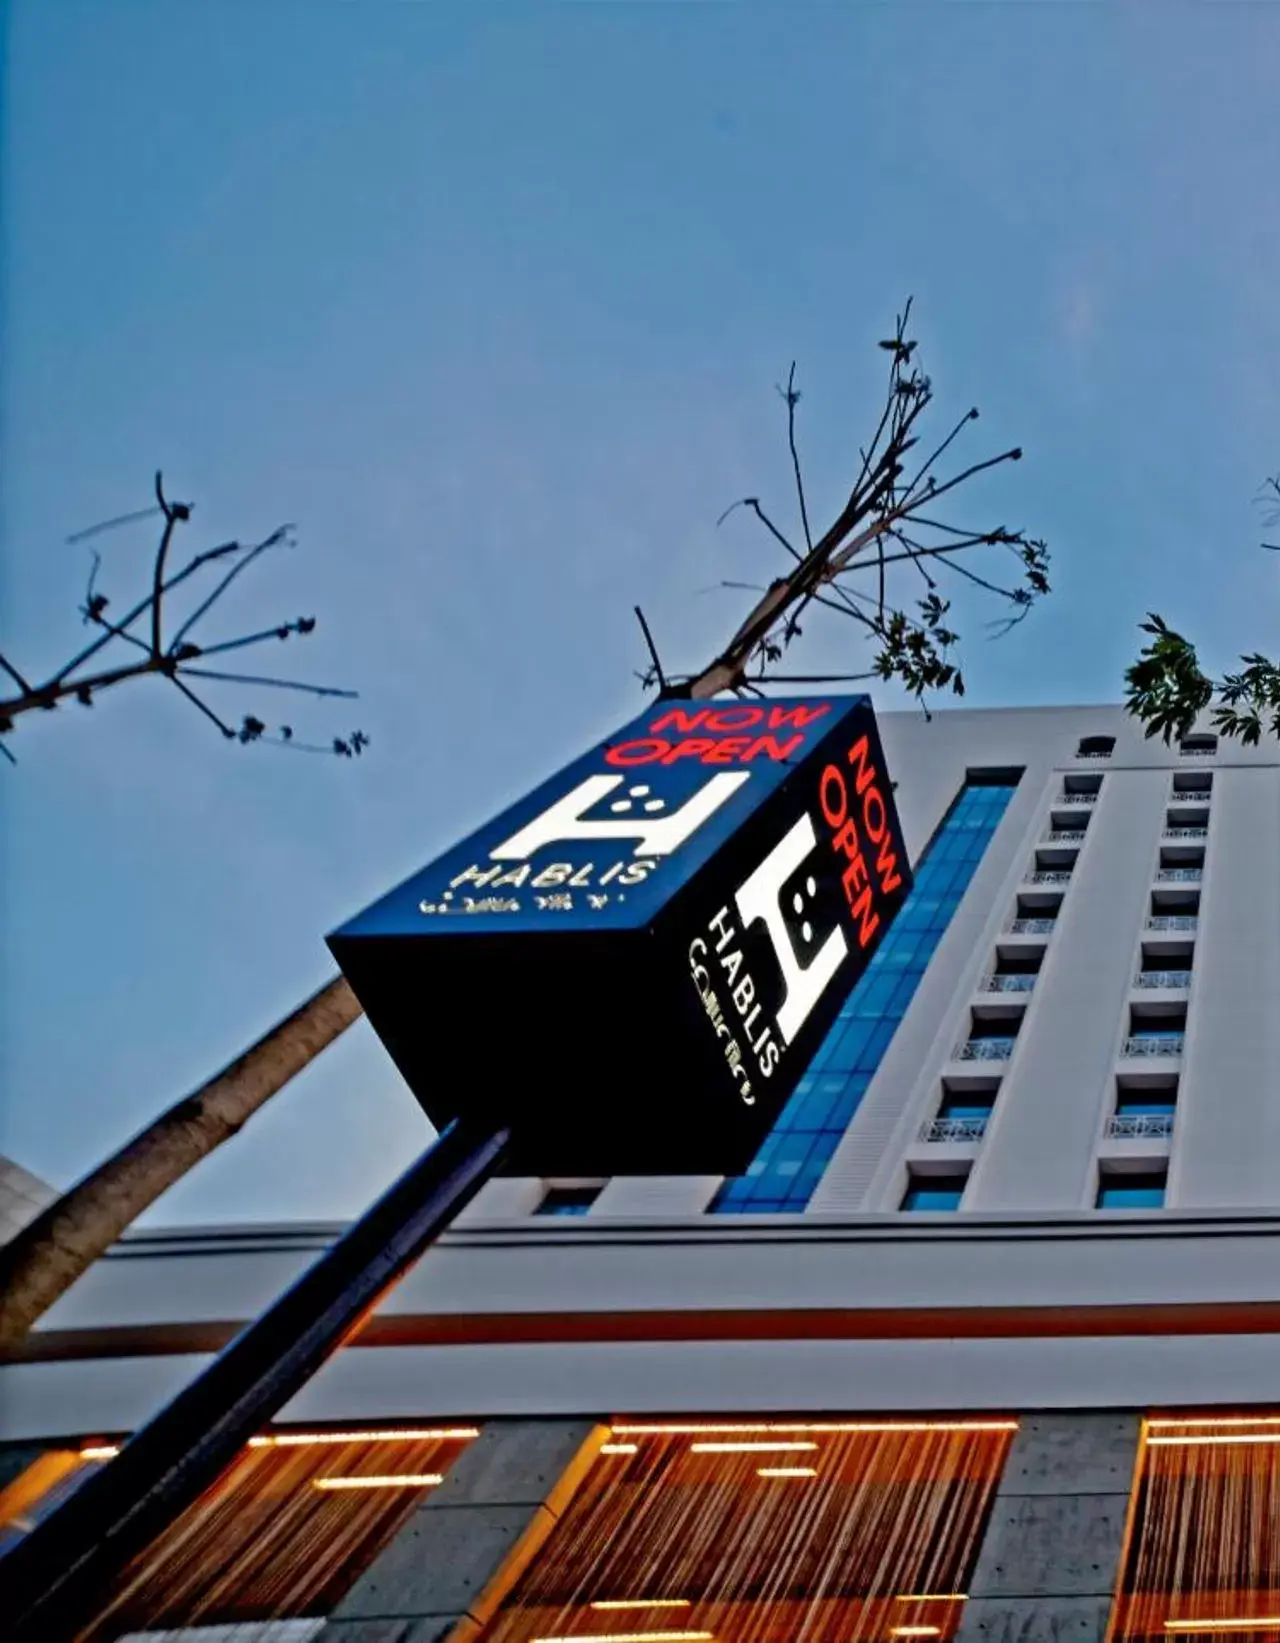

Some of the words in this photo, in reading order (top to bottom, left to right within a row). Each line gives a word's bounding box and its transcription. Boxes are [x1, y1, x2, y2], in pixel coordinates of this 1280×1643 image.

[604, 733, 805, 767] OPEN
[649, 704, 830, 733] NOW
[820, 764, 881, 948] OPEN
[848, 735, 903, 895] NOW
[449, 861, 656, 889] HABLIS
[708, 905, 779, 1078] HABLIS
